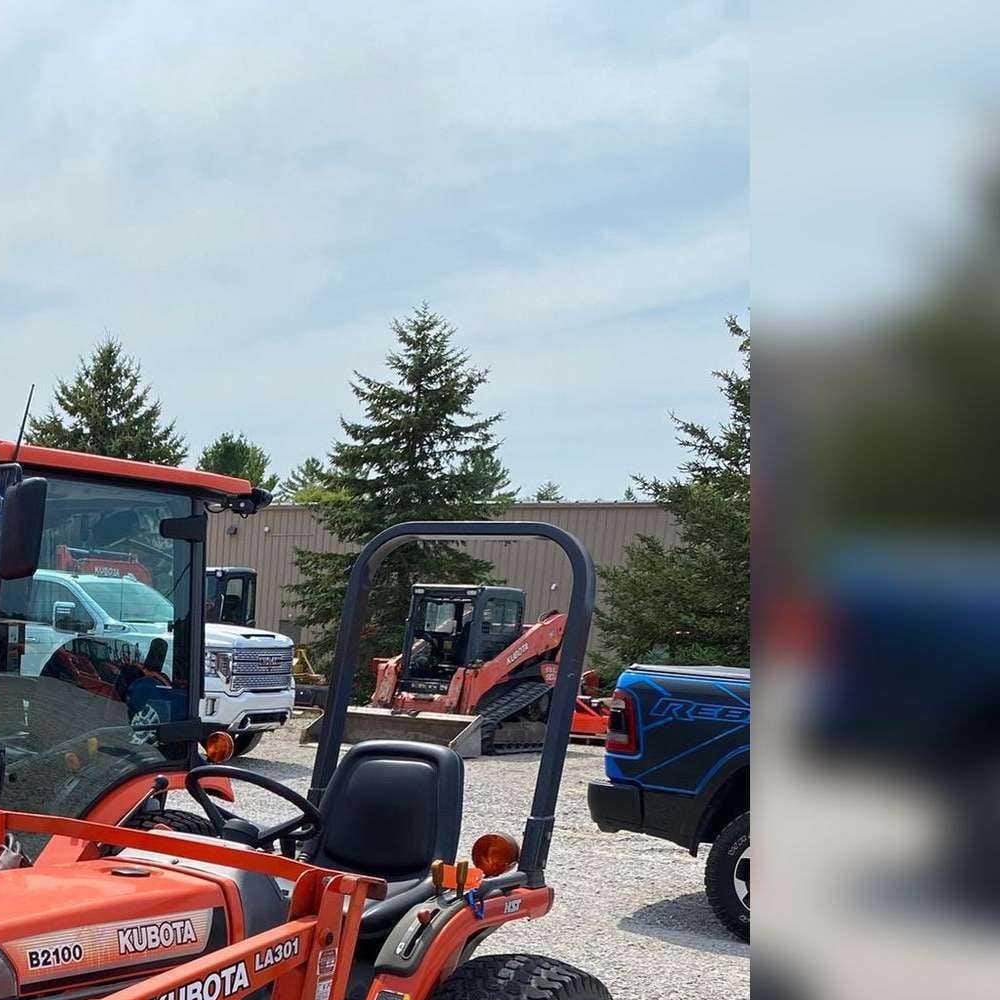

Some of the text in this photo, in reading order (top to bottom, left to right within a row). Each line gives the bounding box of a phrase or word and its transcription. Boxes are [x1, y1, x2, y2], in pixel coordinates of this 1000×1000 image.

[117, 919, 198, 955] KUBOTA
[254, 936, 300, 973] LA301
[28, 944, 84, 969] B2100
